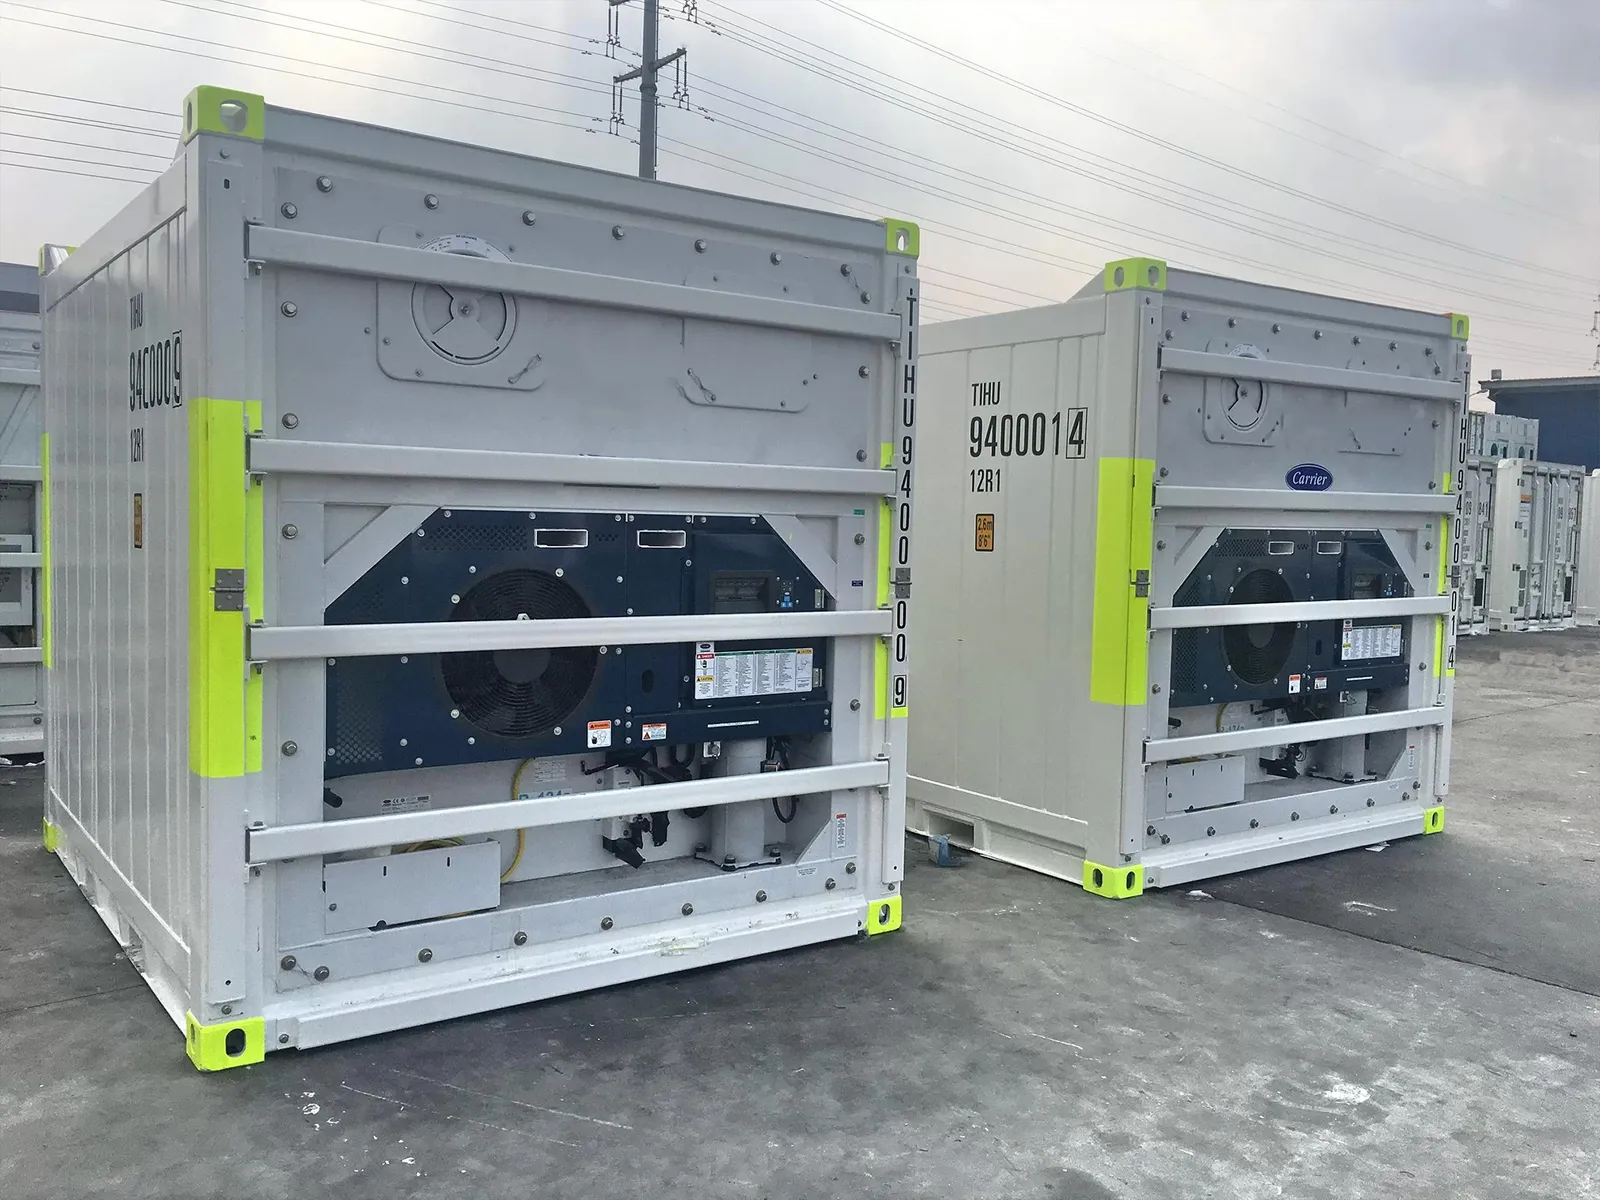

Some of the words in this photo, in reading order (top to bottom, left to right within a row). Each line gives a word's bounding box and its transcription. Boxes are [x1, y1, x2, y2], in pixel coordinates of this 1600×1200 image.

[904, 298, 917, 427] TIHU
[971, 381, 1001, 406] TIHU
[1459, 371, 1470, 464] TIHU
[969, 468, 1001, 493] 12R1
[1292, 471, 1328, 486] Carrier
